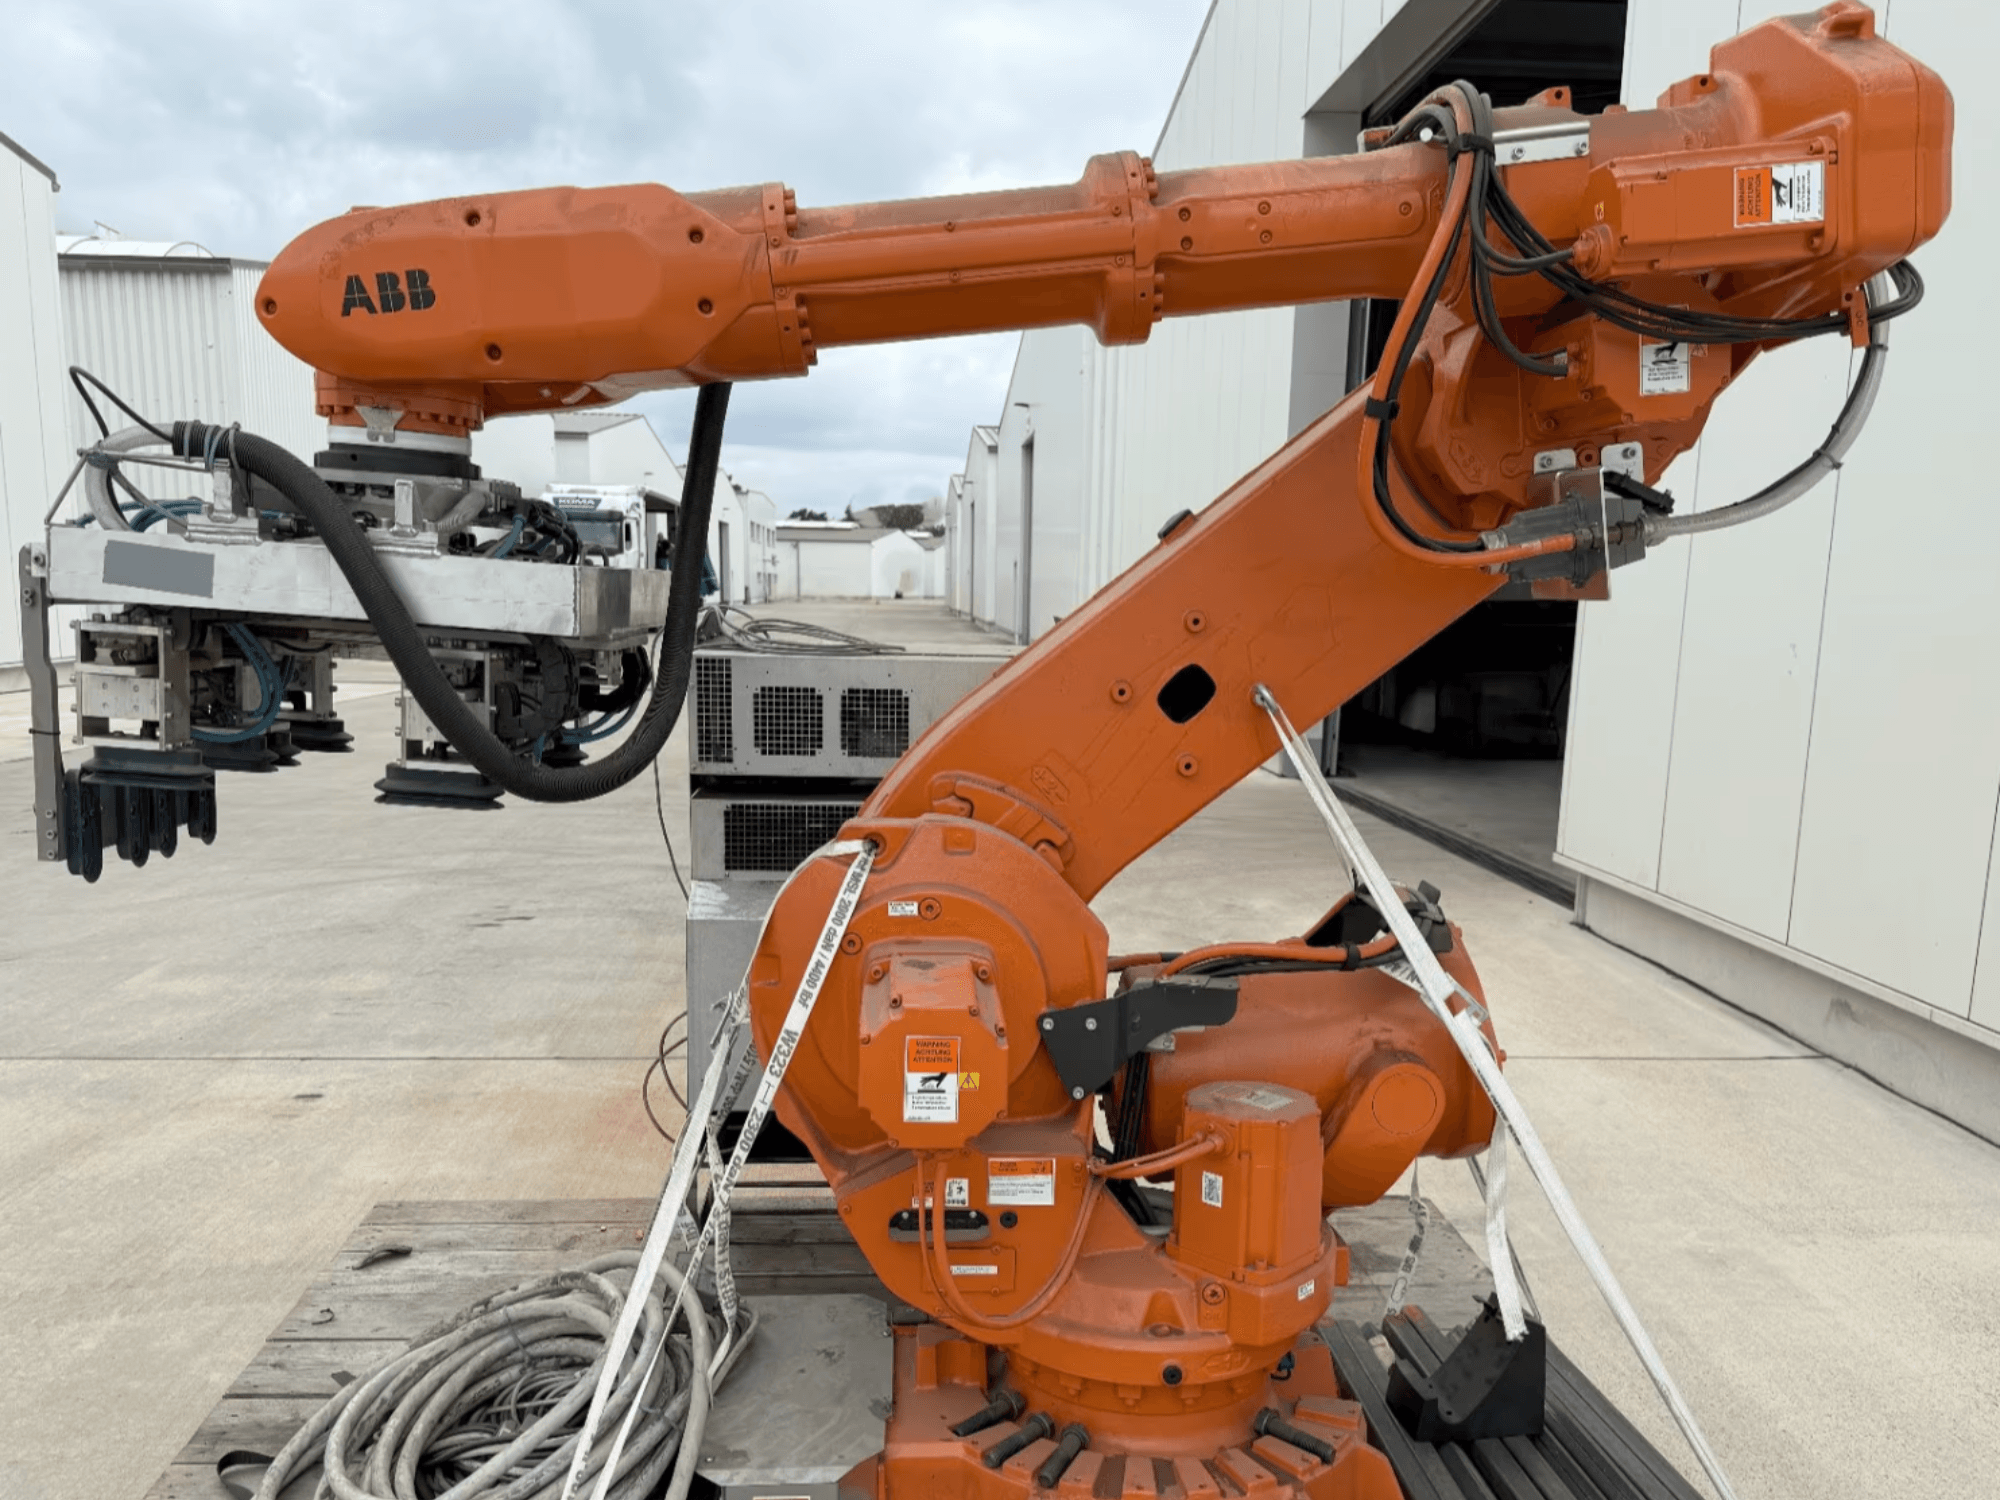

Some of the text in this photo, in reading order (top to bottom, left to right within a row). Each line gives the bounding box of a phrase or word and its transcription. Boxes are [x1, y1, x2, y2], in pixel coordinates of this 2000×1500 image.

[341, 268, 436, 317] ABB
[832, 897, 852, 927] 2000
[821, 926, 838, 951] daN
[806, 959, 826, 990] 4400
[769, 1028, 799, 1079] W323
[915, 1040, 951, 1048] WARNING
[915, 1048, 951, 1056] ACHTUNG
[912, 1056, 953, 1064] ATTENTION
[739, 1105, 764, 1153] 2300
